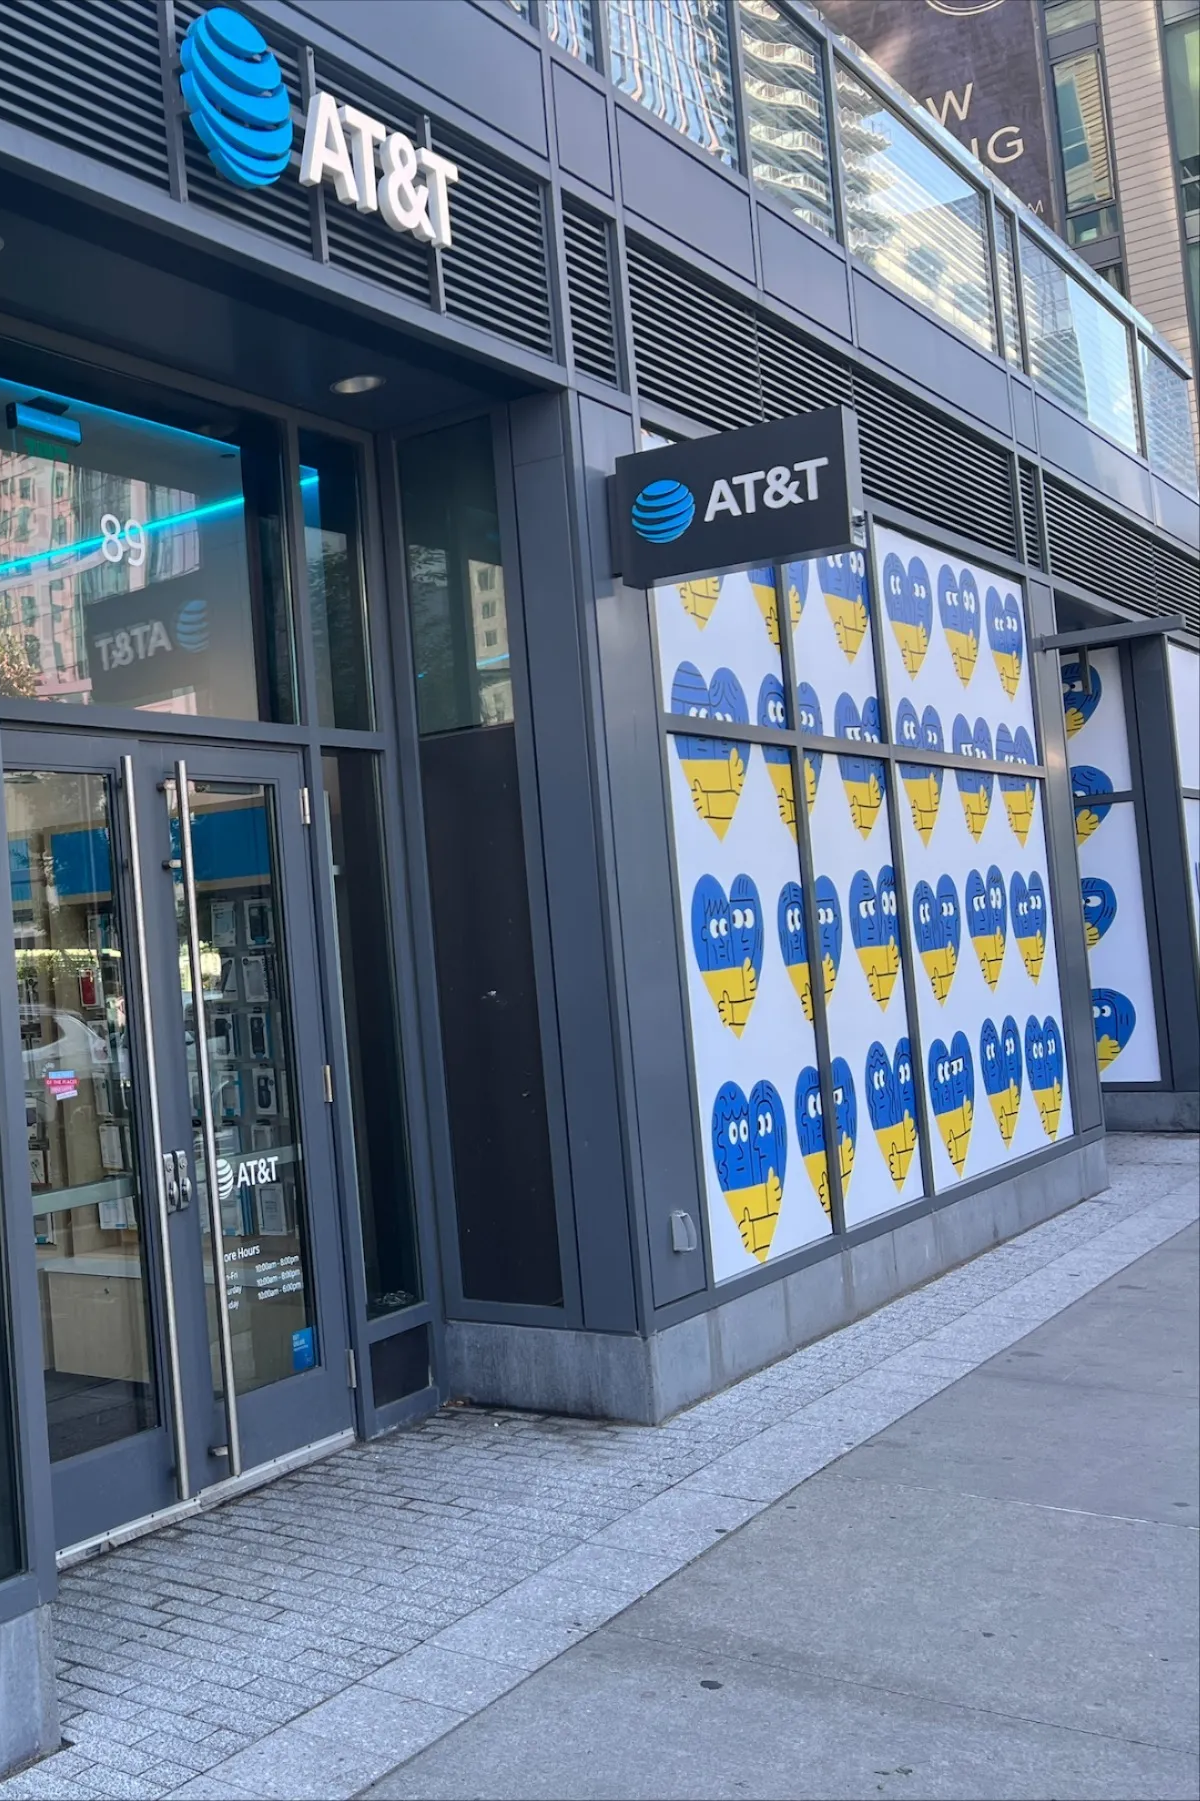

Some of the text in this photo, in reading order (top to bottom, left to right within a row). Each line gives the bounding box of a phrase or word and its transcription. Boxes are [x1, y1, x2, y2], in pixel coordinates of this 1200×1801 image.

[299, 91, 459, 249] AT&T
[704, 456, 829, 523] AT&T
[100, 513, 146, 567] 89
[236, 1155, 279, 1189] AT&T
[224, 1245, 260, 1262] ore Hours
[226, 1272, 238, 1280] -Fri
[227, 1286, 242, 1295] urday
[228, 1301, 239, 1309] day
